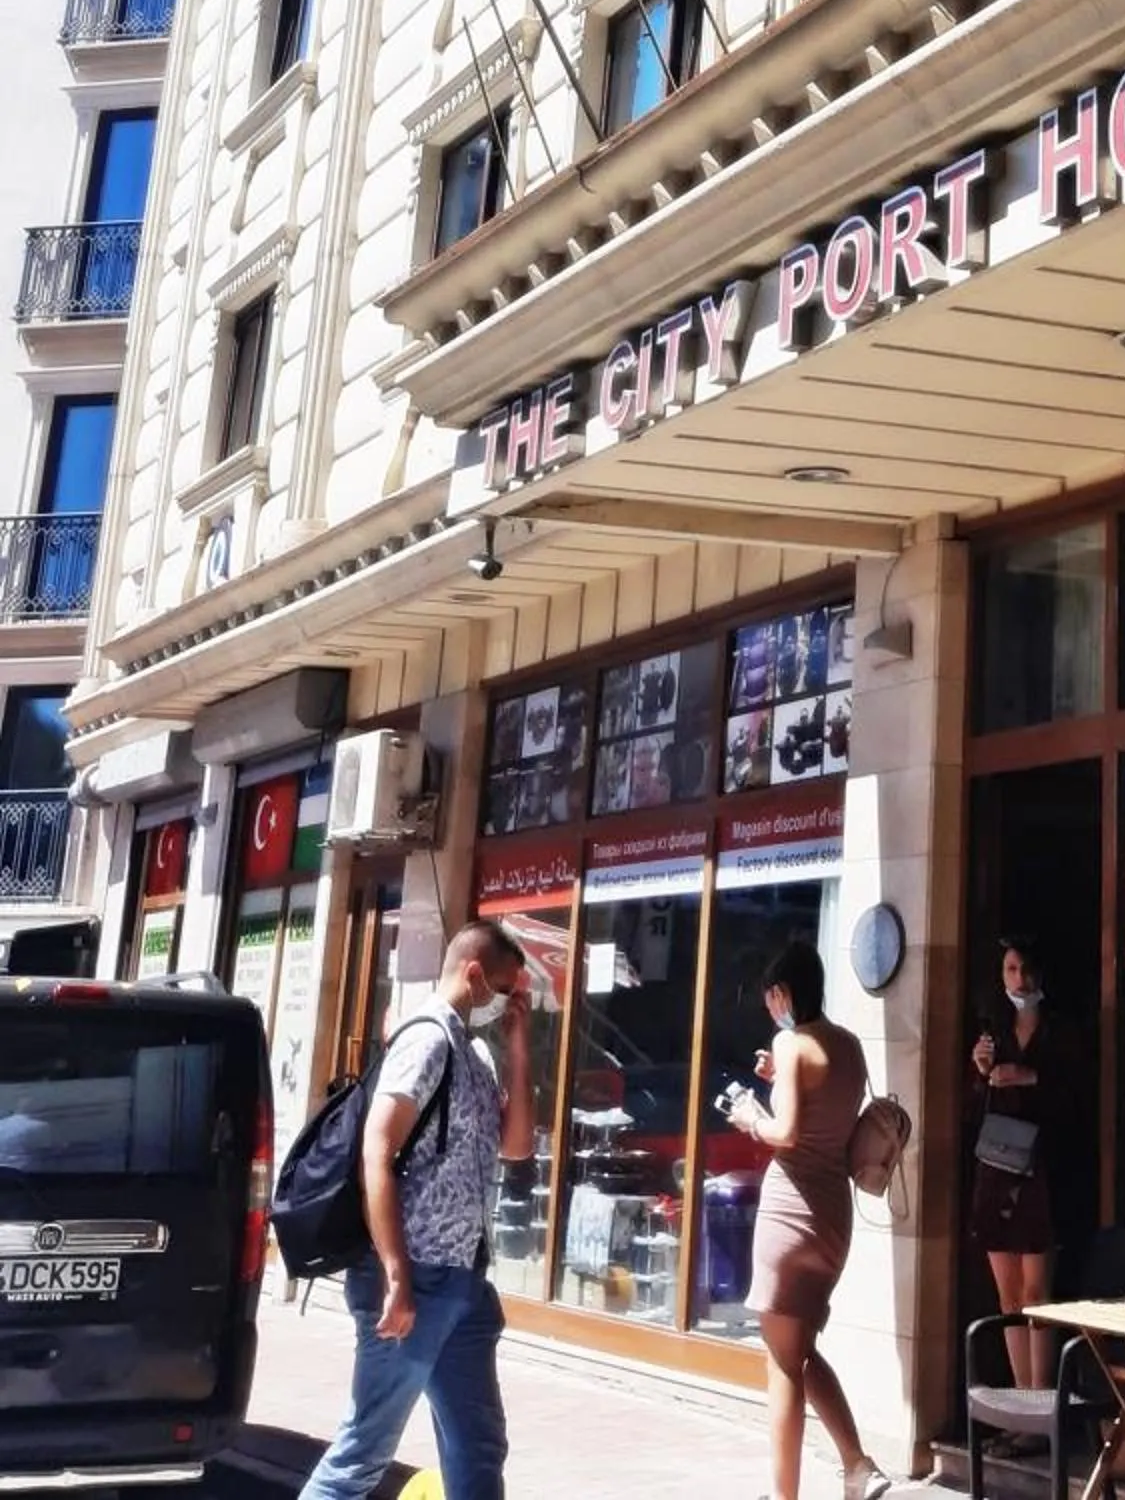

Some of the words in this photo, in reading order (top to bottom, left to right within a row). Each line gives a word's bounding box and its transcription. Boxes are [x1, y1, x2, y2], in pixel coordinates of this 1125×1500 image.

[478, 372, 574, 489] THE
[600, 282, 738, 430] CITY
[777, 148, 988, 352] PORT
[773, 808, 817, 834] discount
[736, 854, 773, 872] Factory
[774, 847, 818, 869] discount
